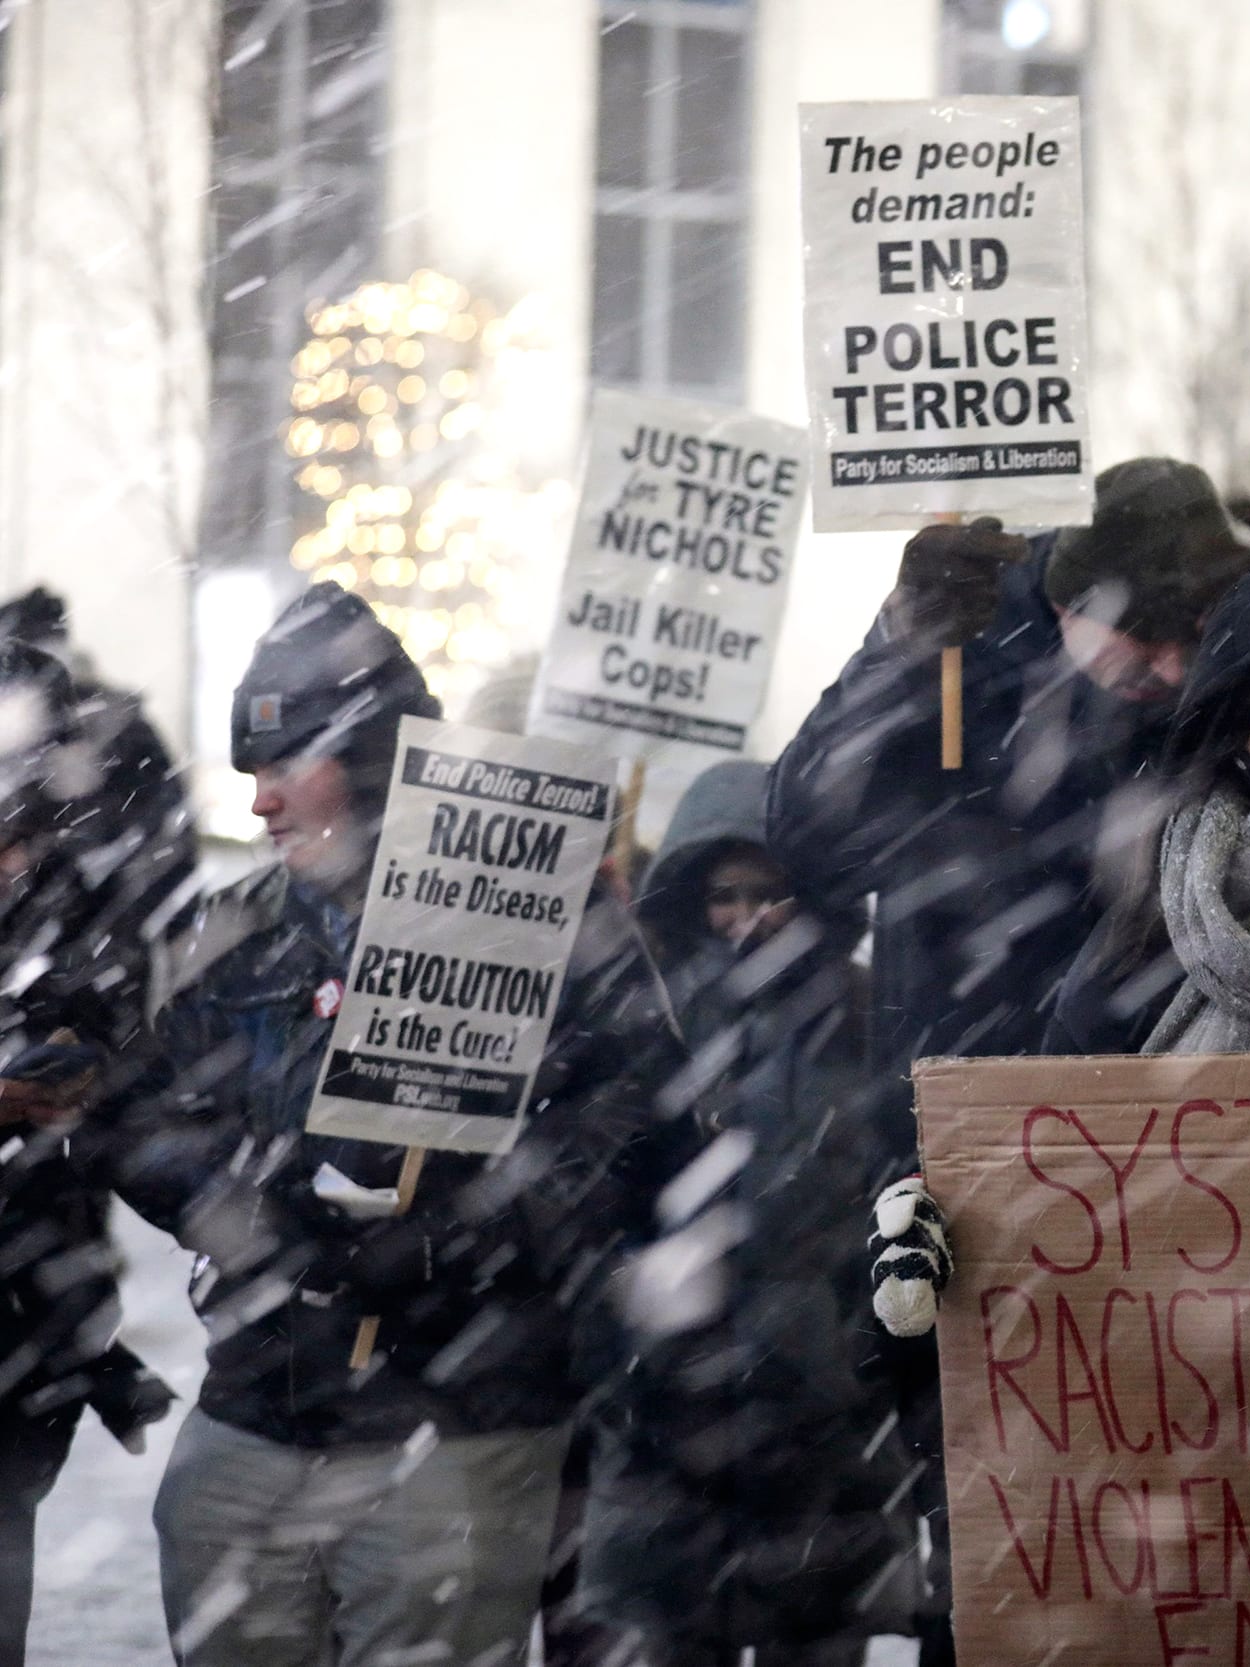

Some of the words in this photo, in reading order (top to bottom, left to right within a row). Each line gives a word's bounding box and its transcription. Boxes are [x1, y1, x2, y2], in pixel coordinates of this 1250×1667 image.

[825, 136, 901, 174] The
[916, 133, 1060, 179] people
[851, 182, 1035, 223] demand:
[877, 237, 1009, 295] END
[845, 318, 1058, 374] POLICE
[833, 377, 1074, 434] TERROR
[622, 427, 798, 497] JUSTICE
[836, 457, 876, 481] Party
[880, 456, 902, 477] for
[906, 453, 979, 475] Socialism
[983, 451, 996, 471] &
[1000, 448, 1077, 470] Liberation
[675, 480, 780, 539] TYRE
[600, 510, 783, 586] NICHOLS
[569, 590, 641, 637] Jail
[654, 604, 762, 661] Killer
[601, 645, 710, 701] Cops!
[420, 754, 467, 788] End
[466, 762, 532, 800] Police
[532, 776, 599, 813] Terror!
[427, 802, 567, 874] RACISM
[382, 860, 408, 898] is
[415, 867, 462, 908] the
[470, 875, 571, 931] Disease,
[354, 944, 555, 1019] REVOLUTION
[366, 1008, 390, 1047] is
[397, 1011, 442, 1053] the
[450, 1020, 518, 1063] Cure!
